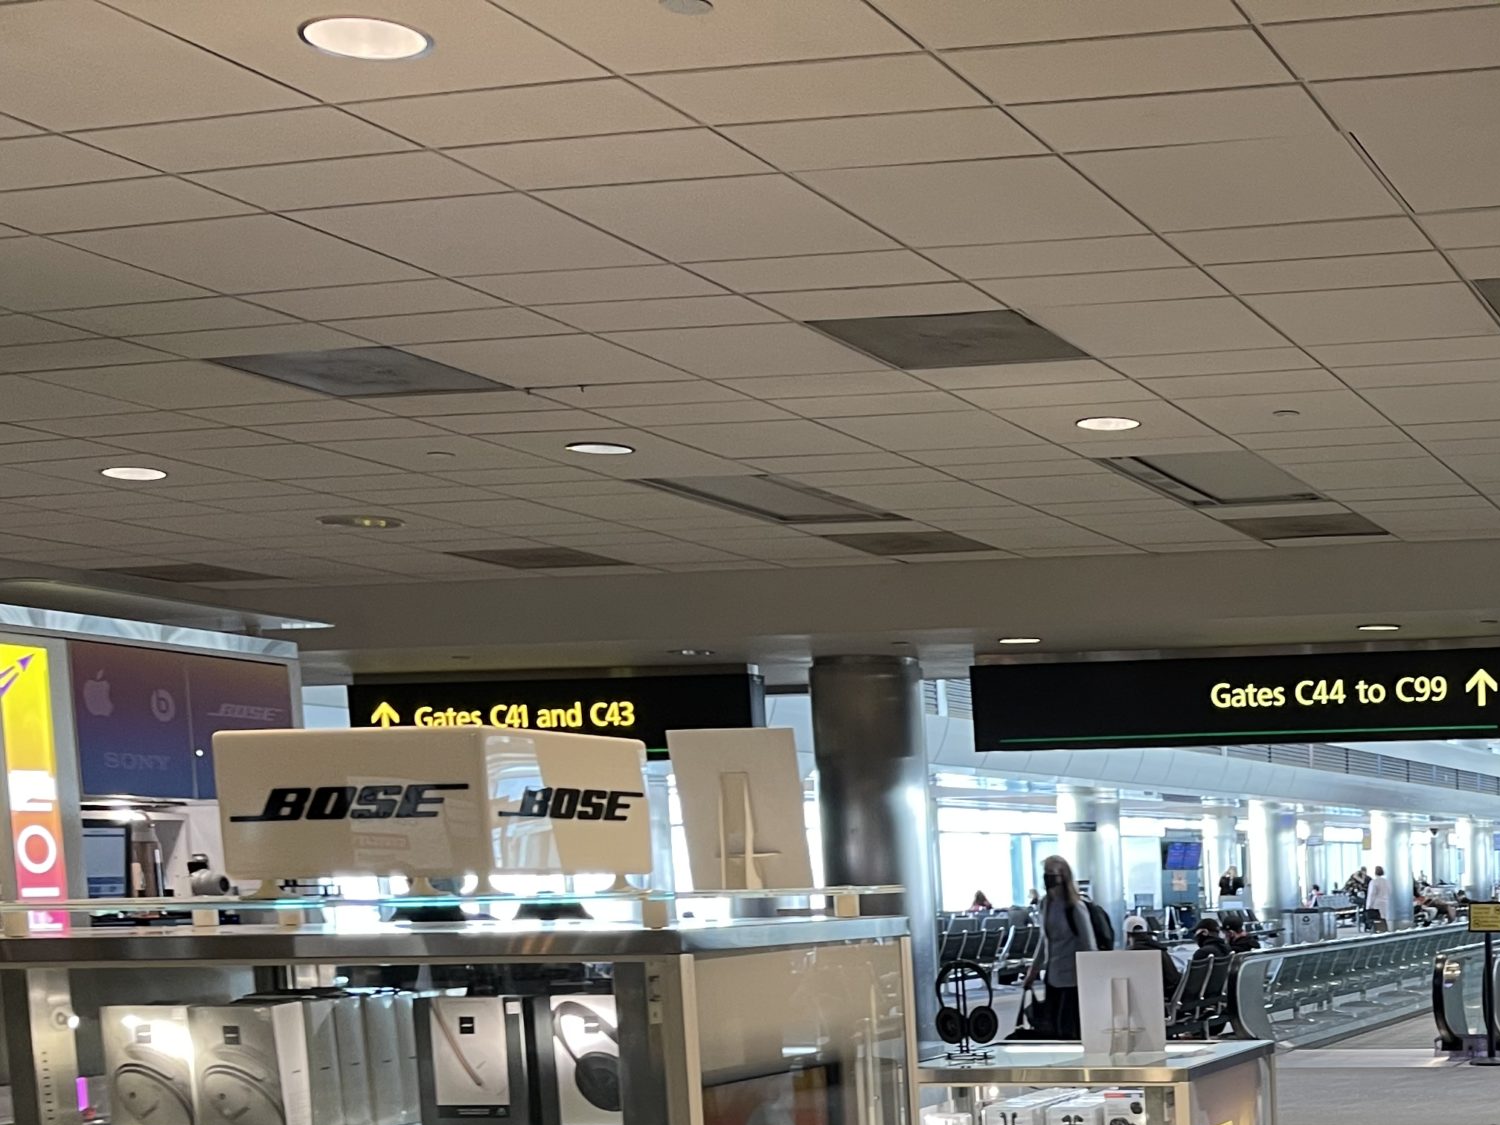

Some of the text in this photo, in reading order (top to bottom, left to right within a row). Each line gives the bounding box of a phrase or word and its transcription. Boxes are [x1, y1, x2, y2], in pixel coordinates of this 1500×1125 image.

[1210, 676, 1448, 708] Gates C44 to C99
[206, 703, 285, 722] BOSE
[414, 701, 636, 728] Gates C41 and C43
[103, 751, 171, 770] SONY
[230, 783, 469, 823] BOSE
[498, 786, 644, 821] BOSE
